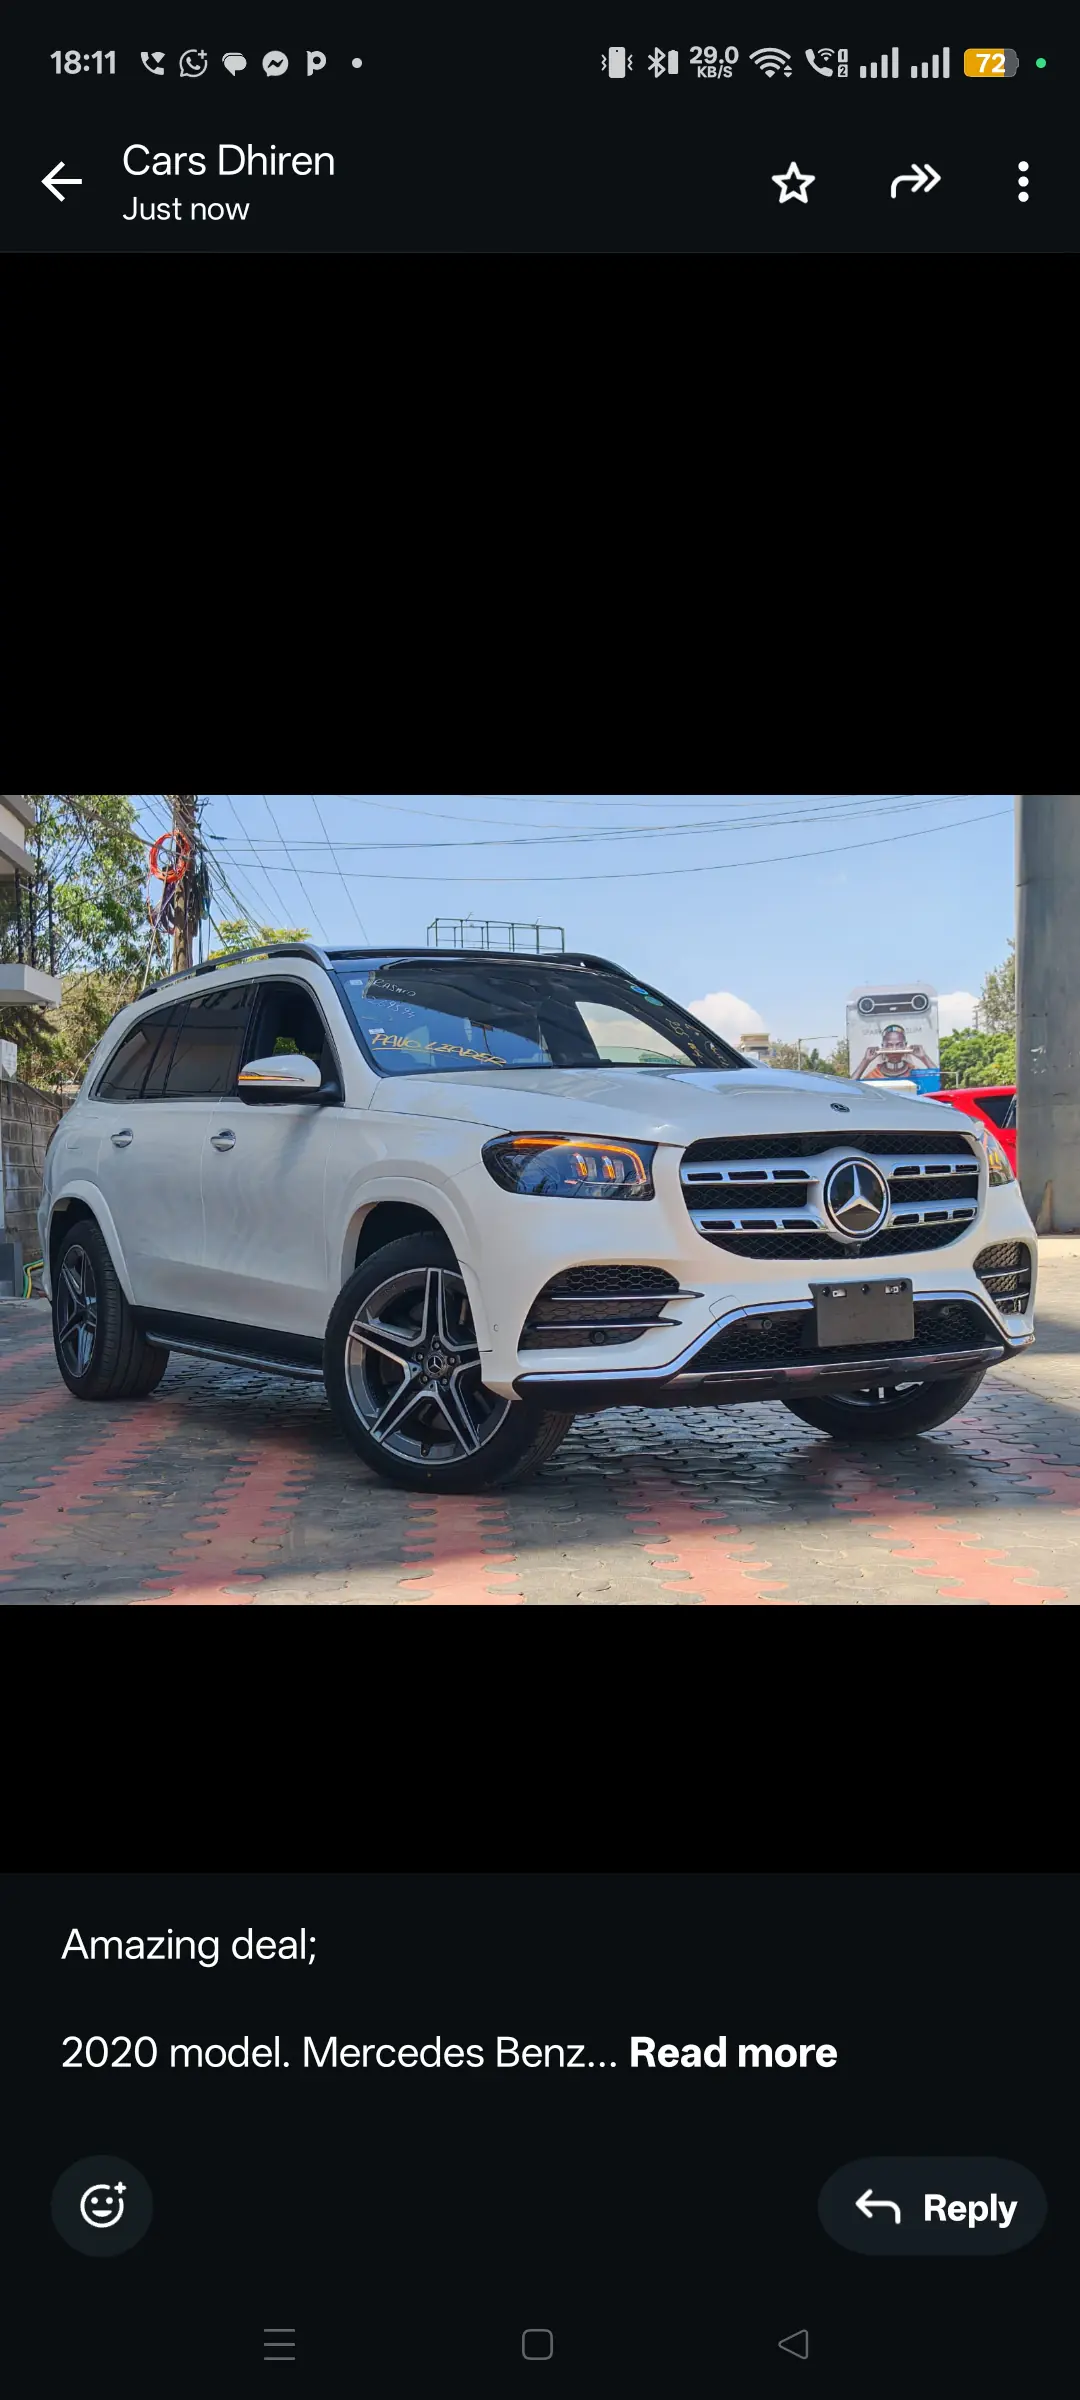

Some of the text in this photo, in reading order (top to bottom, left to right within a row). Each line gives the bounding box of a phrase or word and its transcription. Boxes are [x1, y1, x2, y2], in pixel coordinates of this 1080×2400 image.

[50, 49, 116, 75] 18:11
[689, 45, 740, 66] 29.0
[975, 53, 1006, 74] 72
[697, 65, 733, 79] KB/S
[122, 143, 335, 176] Cars Dhiren
[122, 196, 251, 221] Just now
[60, 1927, 316, 1968] Amazing deal;
[62, 2035, 838, 2068] 2020 model. Mercedes Benz... Read more
[924, 2192, 1019, 2229] Reply
